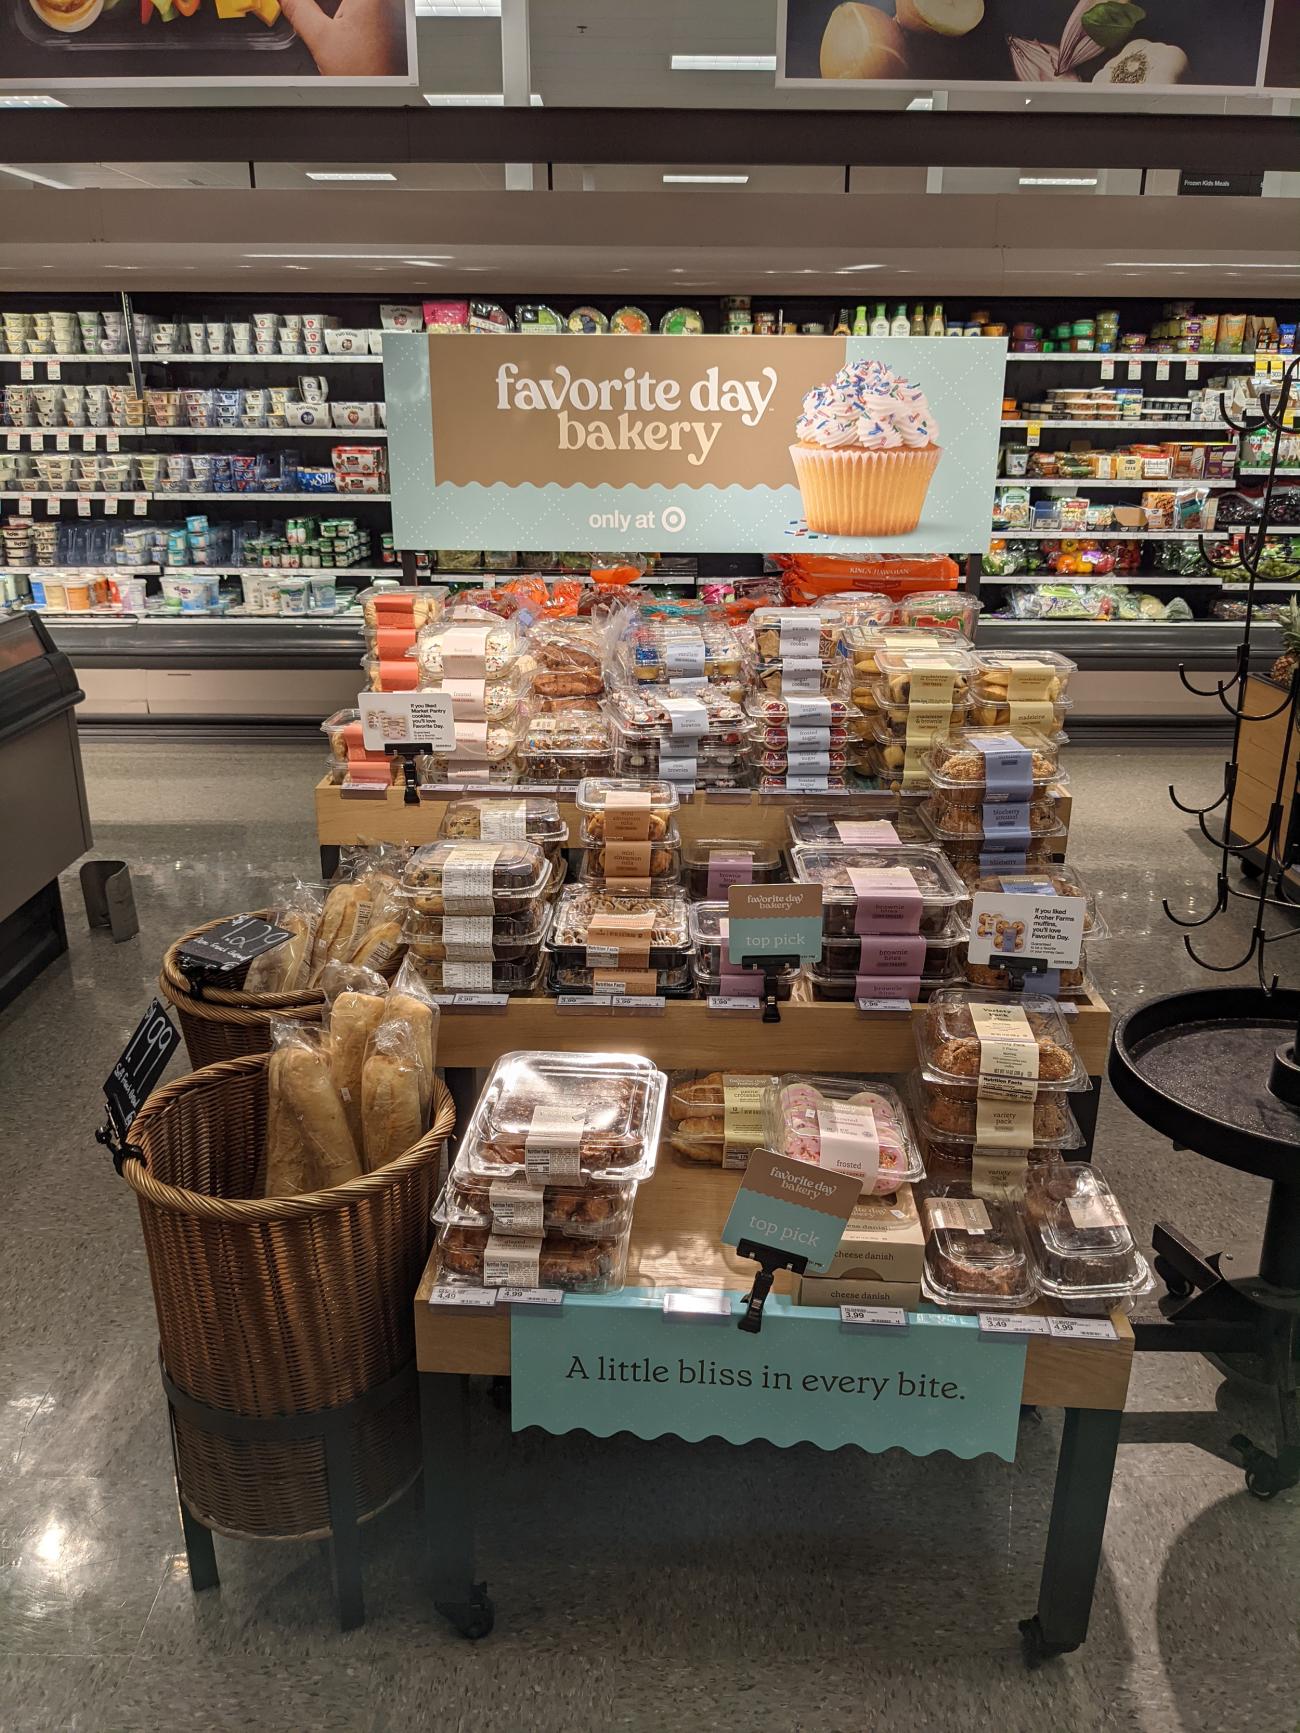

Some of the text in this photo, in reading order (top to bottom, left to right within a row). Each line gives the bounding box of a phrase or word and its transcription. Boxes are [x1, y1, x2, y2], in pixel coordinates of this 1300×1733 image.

[496, 363, 777, 427] favorite day
[558, 413, 722, 465] bakery
[315, 472, 334, 487] Silk
[588, 507, 655, 532] only at
[747, 893, 804, 904] favorite day
[759, 903, 792, 911] bakery
[746, 933, 806, 948] top pick
[836, 1160, 862, 1170] frosted
[770, 1166, 837, 1196] favorite day
[781, 1180, 820, 1200] bakery
[749, 1215, 820, 1248] top pick
[834, 1250, 894, 1261] cheese danish
[830, 1291, 890, 1300] cheese danish
[566, 1356, 966, 1400] A little bliss in every bite.
